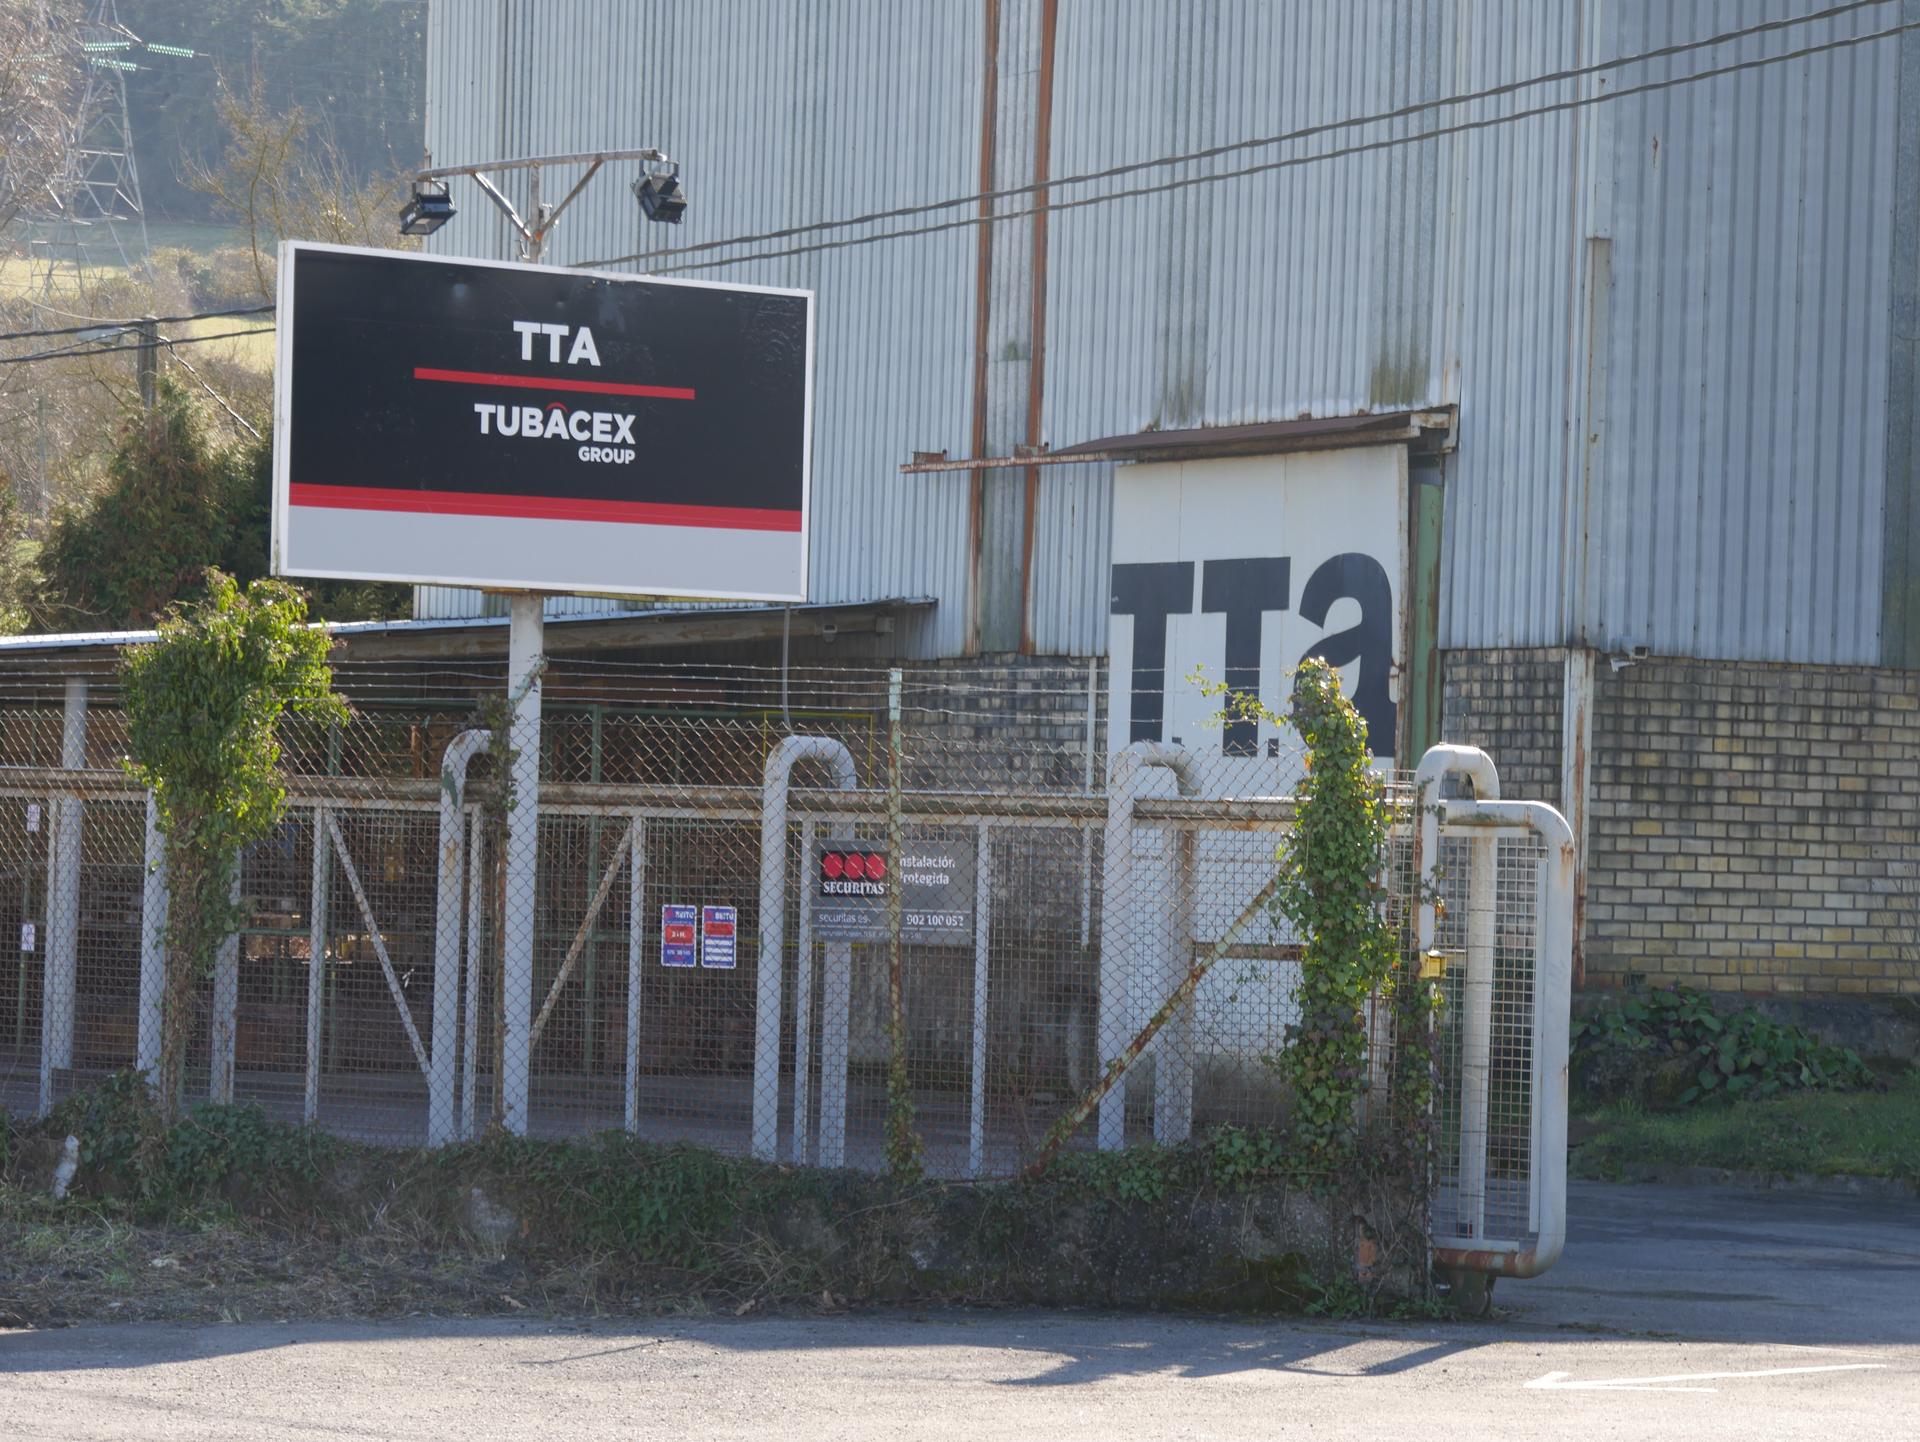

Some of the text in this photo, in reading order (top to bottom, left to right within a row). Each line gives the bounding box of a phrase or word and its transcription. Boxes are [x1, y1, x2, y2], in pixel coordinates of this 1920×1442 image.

[513, 320, 601, 367] TTA
[474, 402, 636, 444] TUBACEX
[578, 446, 635, 465] GROUP
[899, 855, 955, 868] nstalación
[823, 881, 885, 895] SECURITAS
[906, 913, 925, 925] 902
